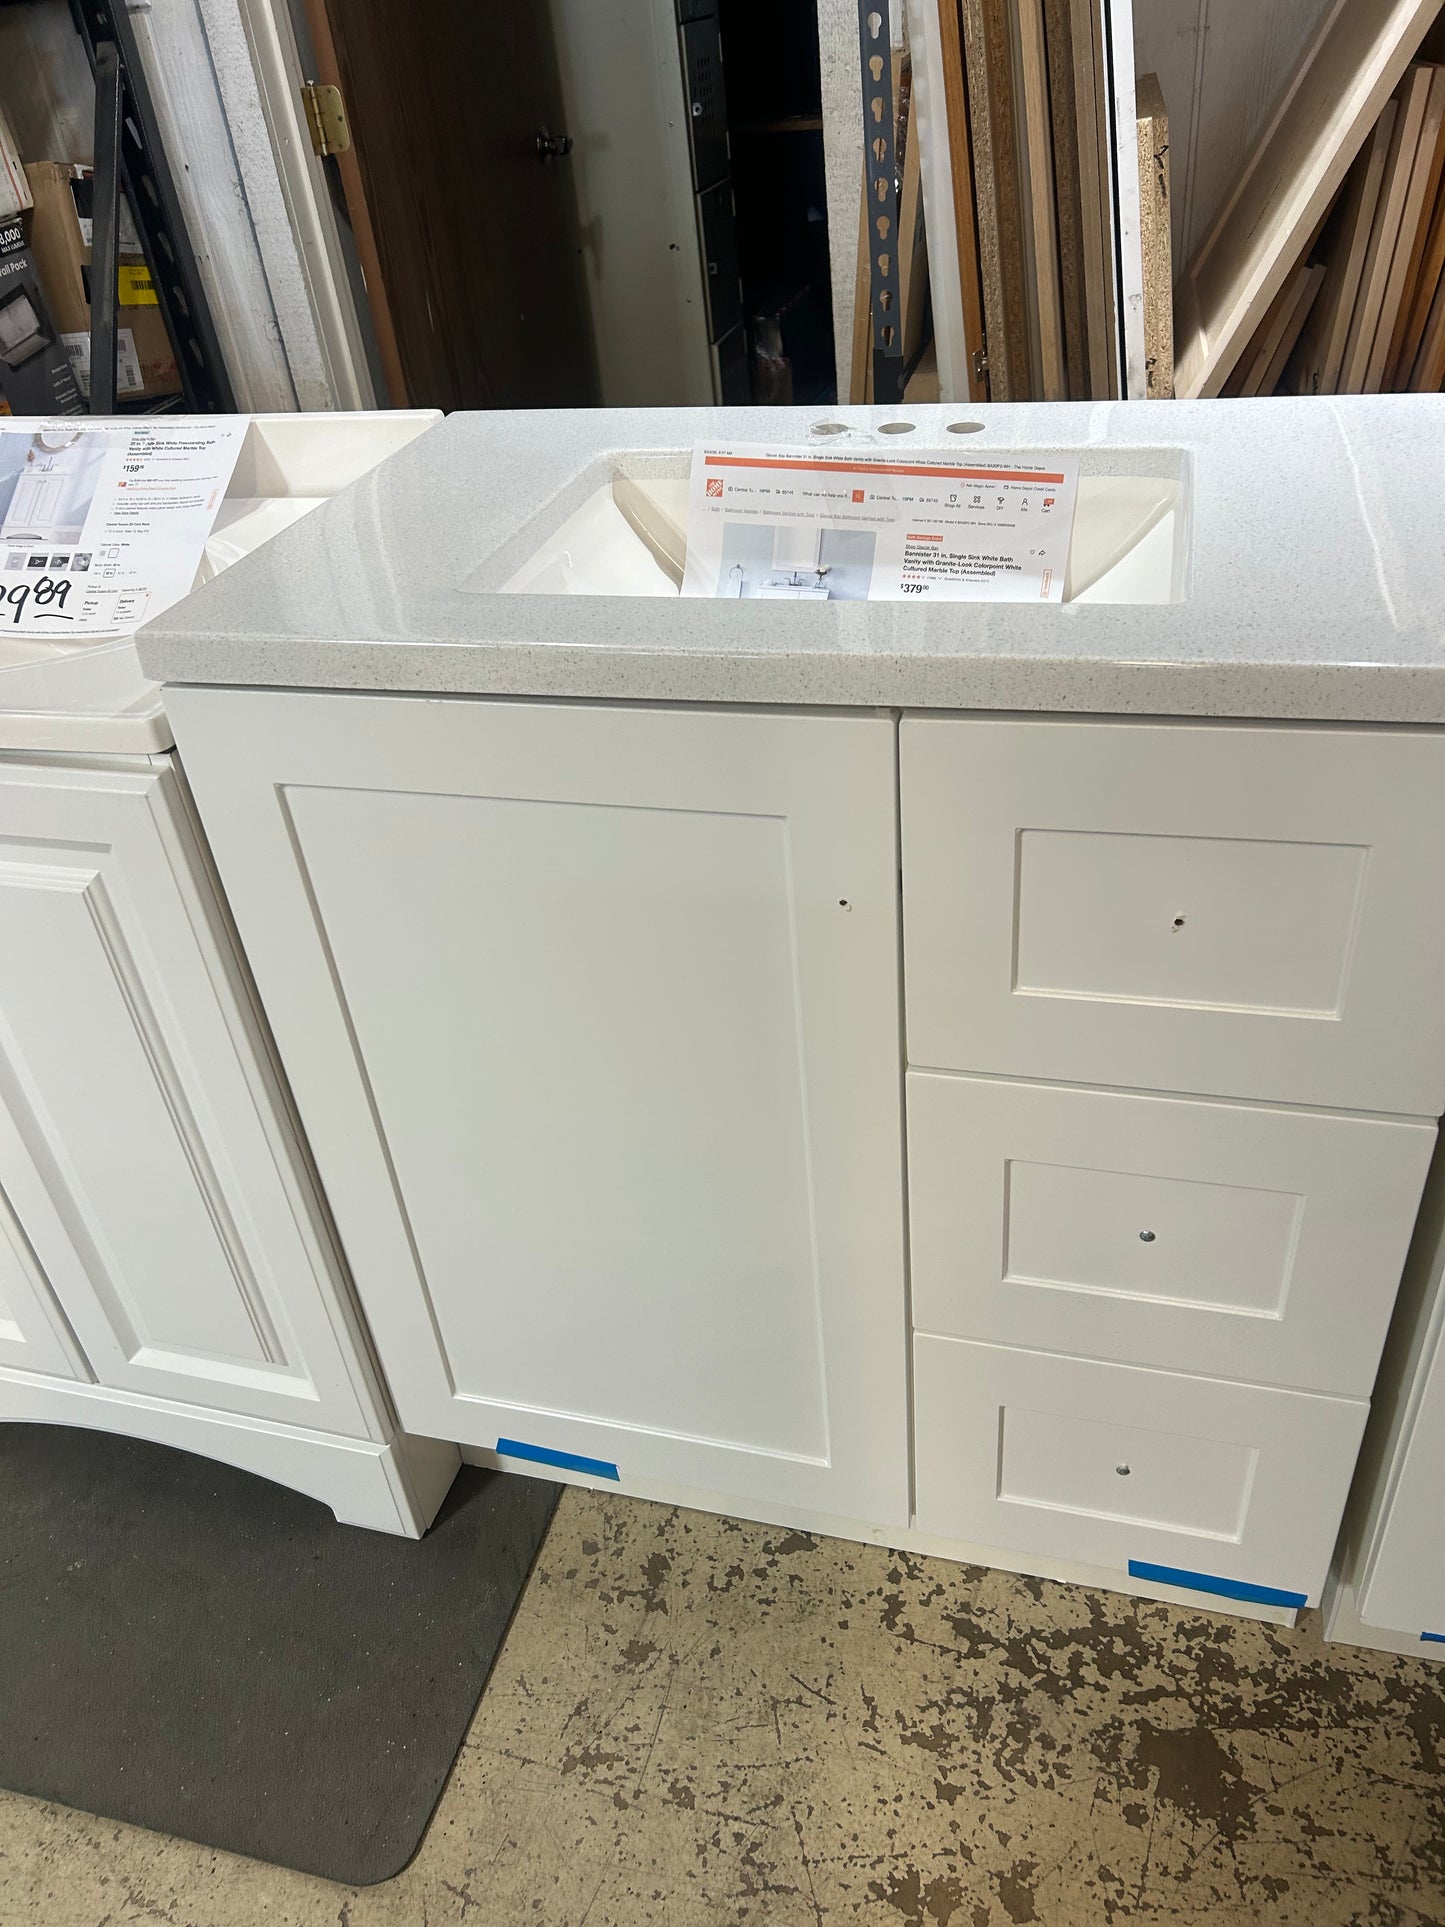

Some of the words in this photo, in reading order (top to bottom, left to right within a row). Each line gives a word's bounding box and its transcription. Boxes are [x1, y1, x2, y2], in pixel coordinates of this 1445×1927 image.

[0, 265, 11, 277] all
[10, 258, 28, 272] Pack
[935, 560, 972, 568] Granite-Look
[973, 562, 1004, 570] Colorpoint
[960, 568, 996, 577] (Assembled)
